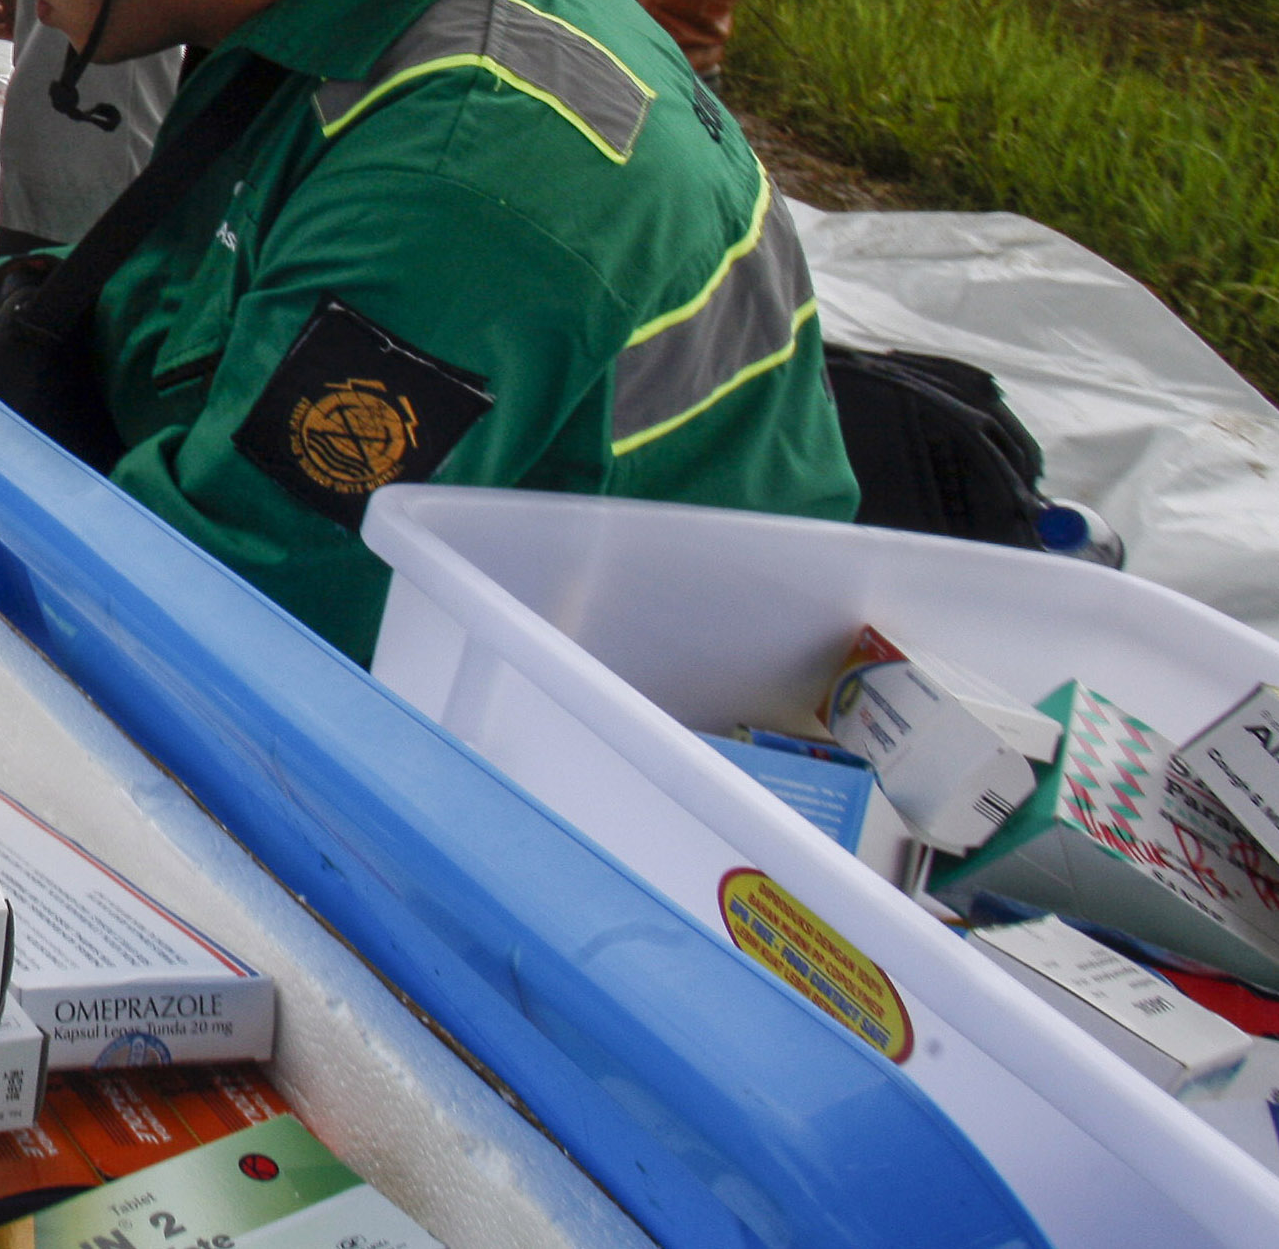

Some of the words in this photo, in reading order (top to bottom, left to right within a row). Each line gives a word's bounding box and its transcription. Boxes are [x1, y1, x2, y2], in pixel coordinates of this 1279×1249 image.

[55, 994, 223, 1025] OMEPRAZOLE
[53, 1027, 100, 1043] Kapsul
[146, 1021, 187, 1036] Tunda
[192, 1021, 209, 1034] 20
[211, 1021, 234, 1038] mg
[108, 1191, 158, 1217] Tablet
[149, 1211, 186, 1240] 2
